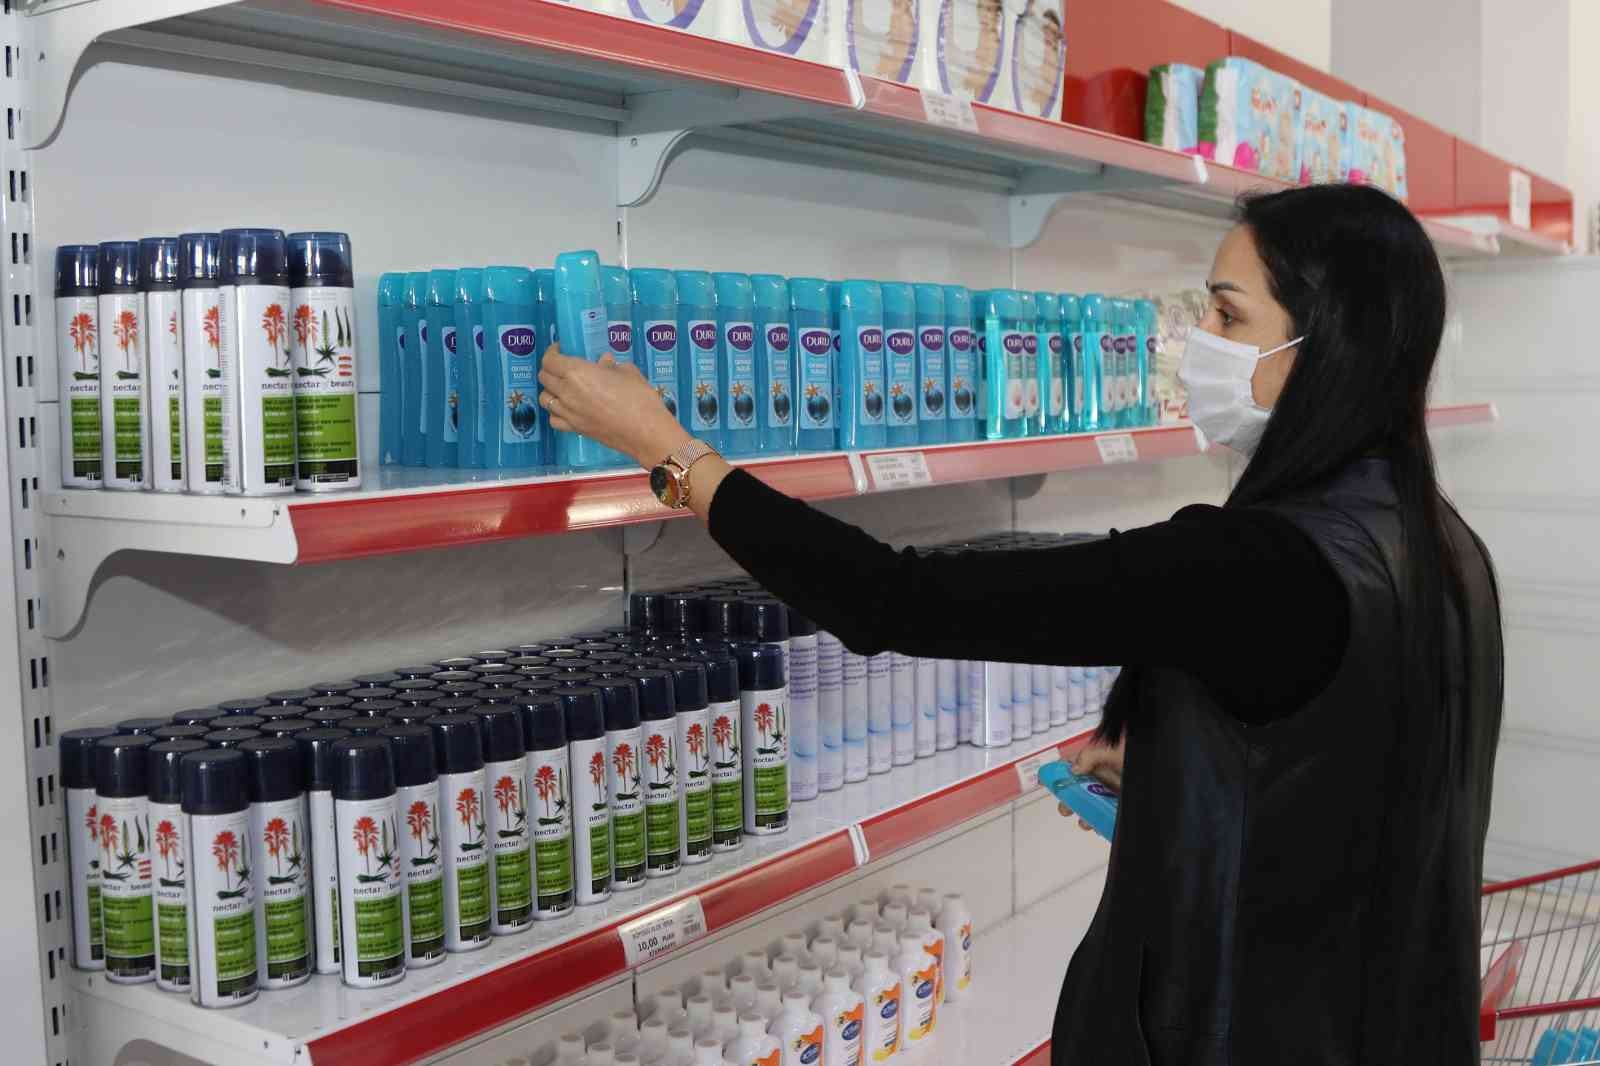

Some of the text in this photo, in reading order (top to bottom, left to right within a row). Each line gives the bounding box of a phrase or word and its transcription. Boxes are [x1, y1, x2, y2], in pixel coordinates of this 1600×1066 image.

[508, 335, 534, 346] DURU
[652, 331, 676, 342] DURU
[806, 336, 830, 346] DURU
[892, 336, 913, 347] DURU
[494, 840, 519, 849] nectar
[456, 854, 480, 863] nectar
[407, 868, 432, 878] nectar
[263, 888, 291, 896] nectar
[212, 902, 241, 912] nectar
[638, 936, 658, 952] 10,00
